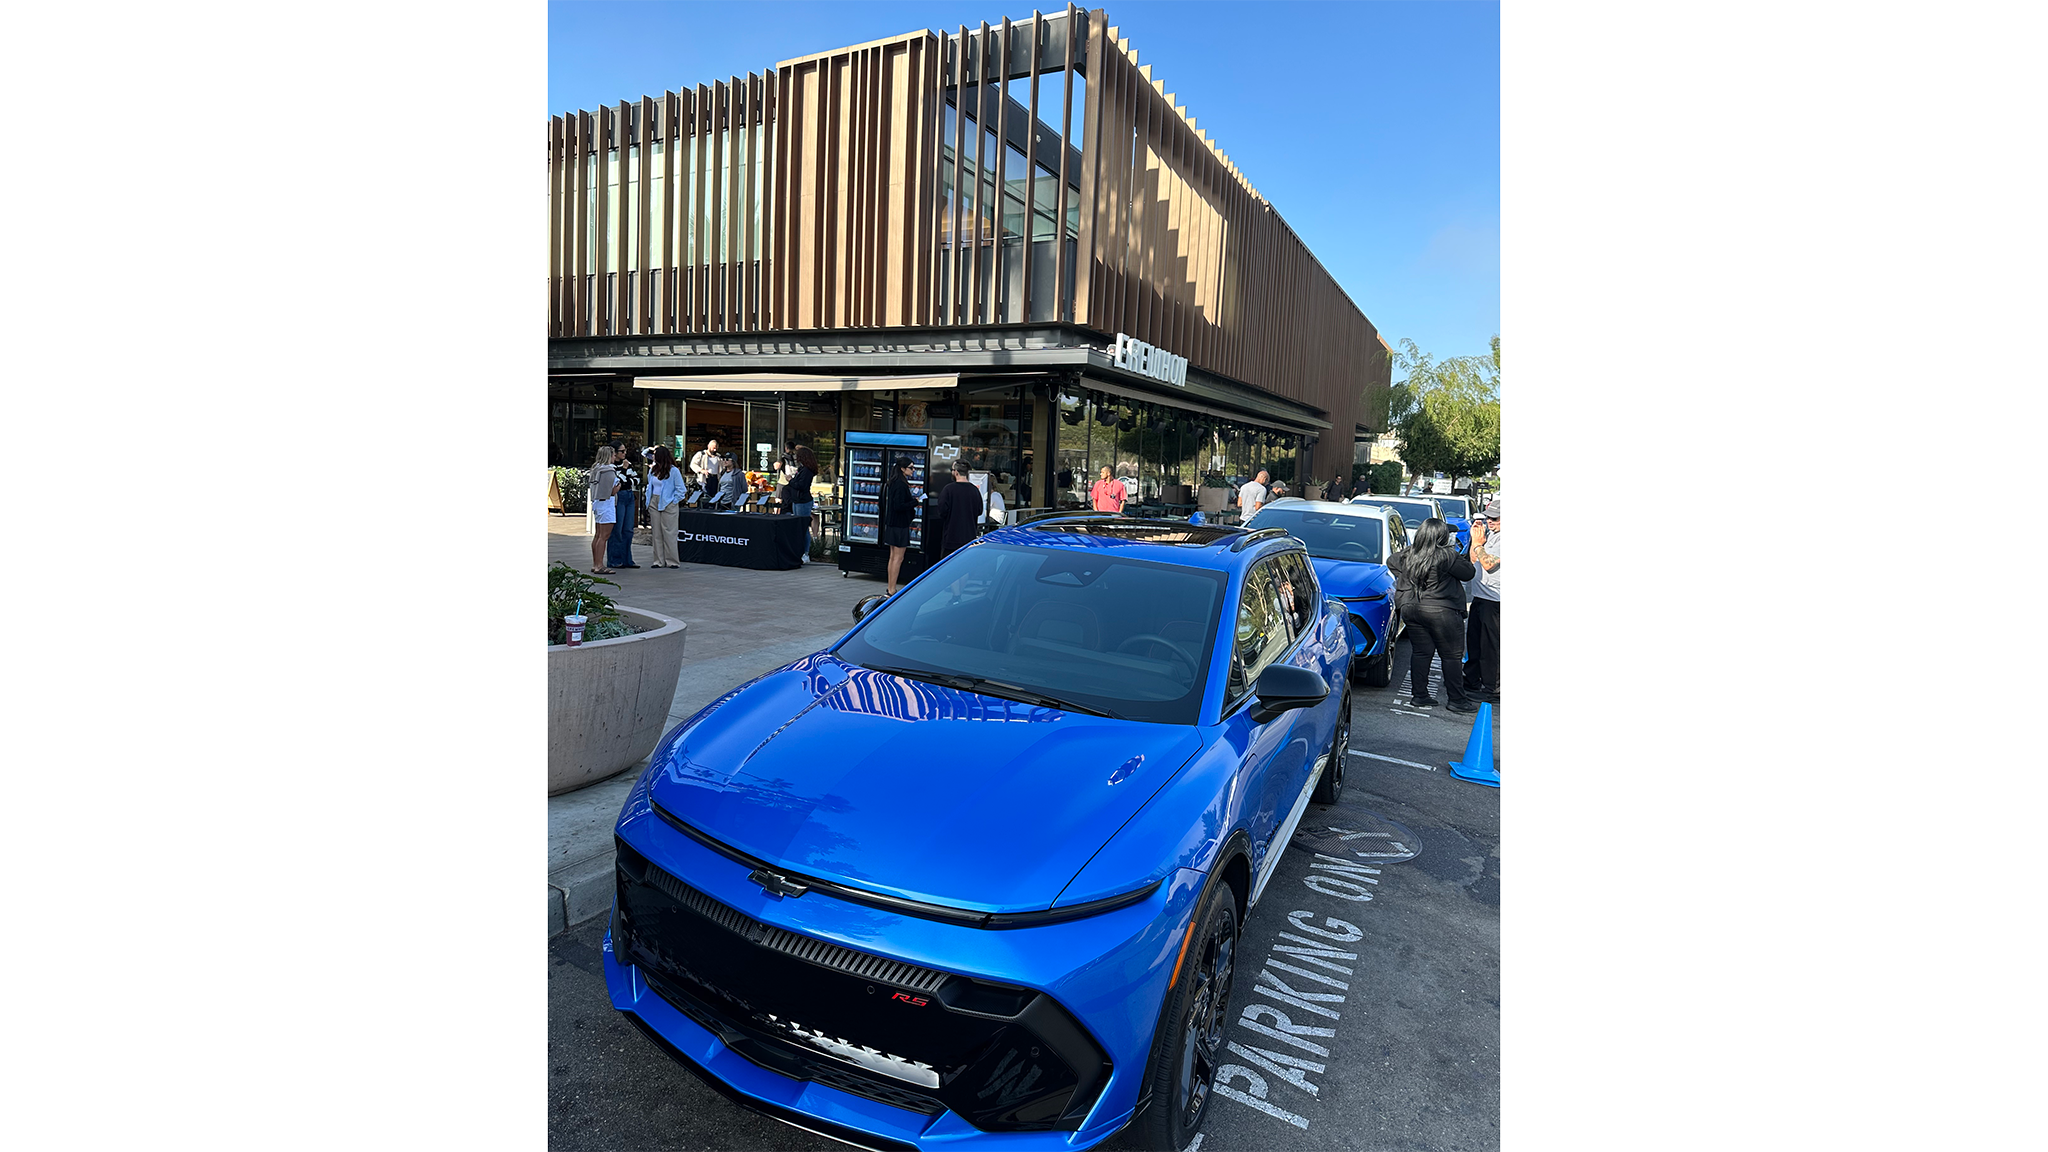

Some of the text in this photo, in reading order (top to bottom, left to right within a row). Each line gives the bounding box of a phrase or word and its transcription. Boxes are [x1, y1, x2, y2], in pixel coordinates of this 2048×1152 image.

[1114, 332, 1188, 387] EREWHON
[695, 533, 750, 546] CHEVROLET
[891, 992, 929, 1007] RS
[1212, 910, 1363, 1130] PARKING
